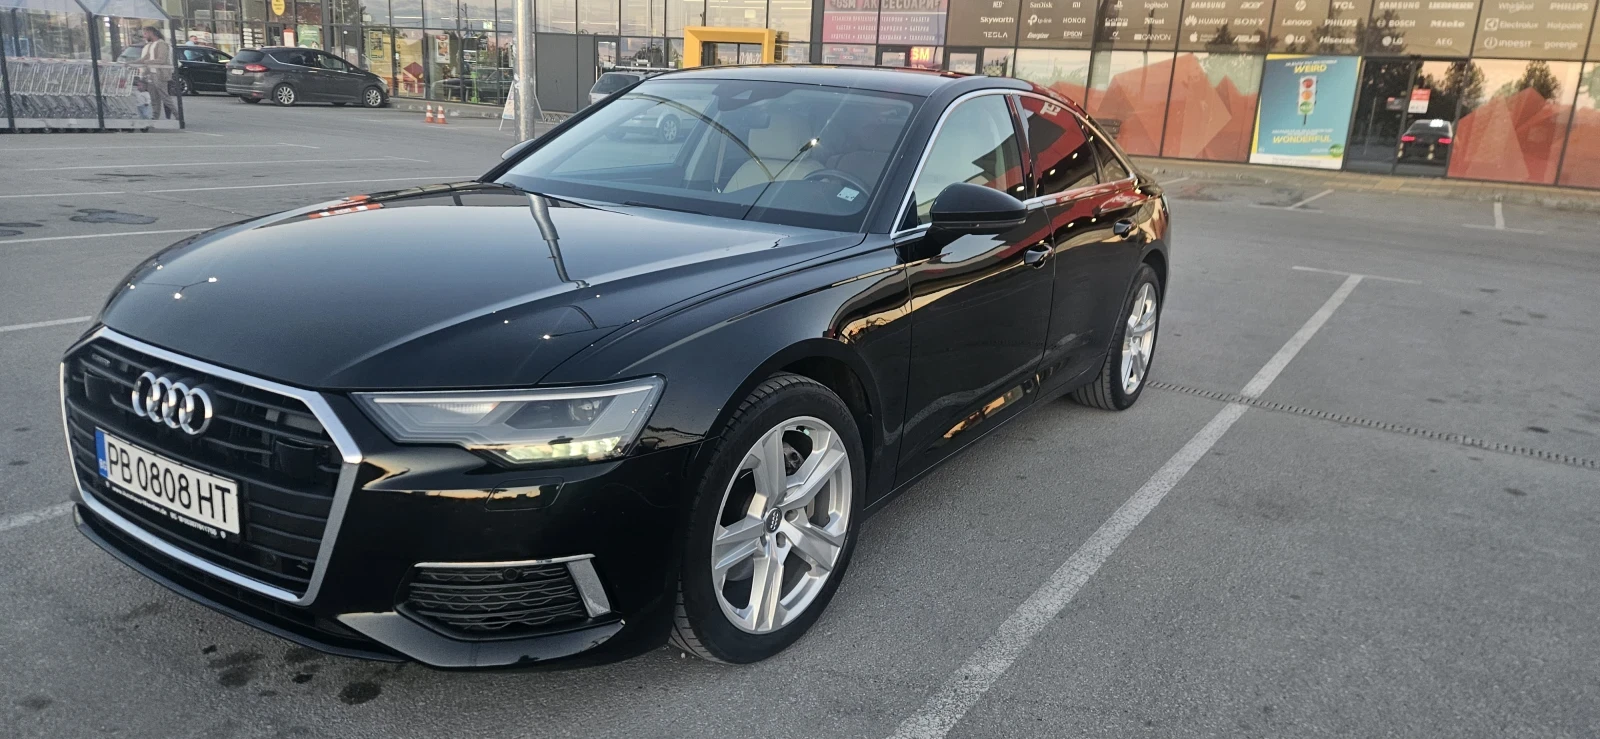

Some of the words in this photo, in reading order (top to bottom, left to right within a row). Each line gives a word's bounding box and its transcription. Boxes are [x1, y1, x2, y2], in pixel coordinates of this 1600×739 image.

[1144, 1, 1168, 9] logitech
[1550, 2, 1589, 10] PHILIPS
[980, 16, 1014, 24] Skyworth
[1282, 18, 1312, 26] Lenovo
[1500, 21, 1539, 29] Electrolux
[1547, 22, 1584, 30] Hotpoint
[1233, 34, 1260, 43] ASUS
[1295, 35, 1306, 43] LG
[1319, 36, 1356, 44] Hisense
[1392, 37, 1403, 45] LG
[1435, 38, 1453, 46] AEG
[1544, 41, 1578, 50] gorenje
[1294, 65, 1327, 74] WEIRD
[1272, 135, 1332, 144] WONDERFUL
[108, 441, 133, 484] PB
[137, 456, 192, 509] 0808
[196, 478, 231, 523] HT
